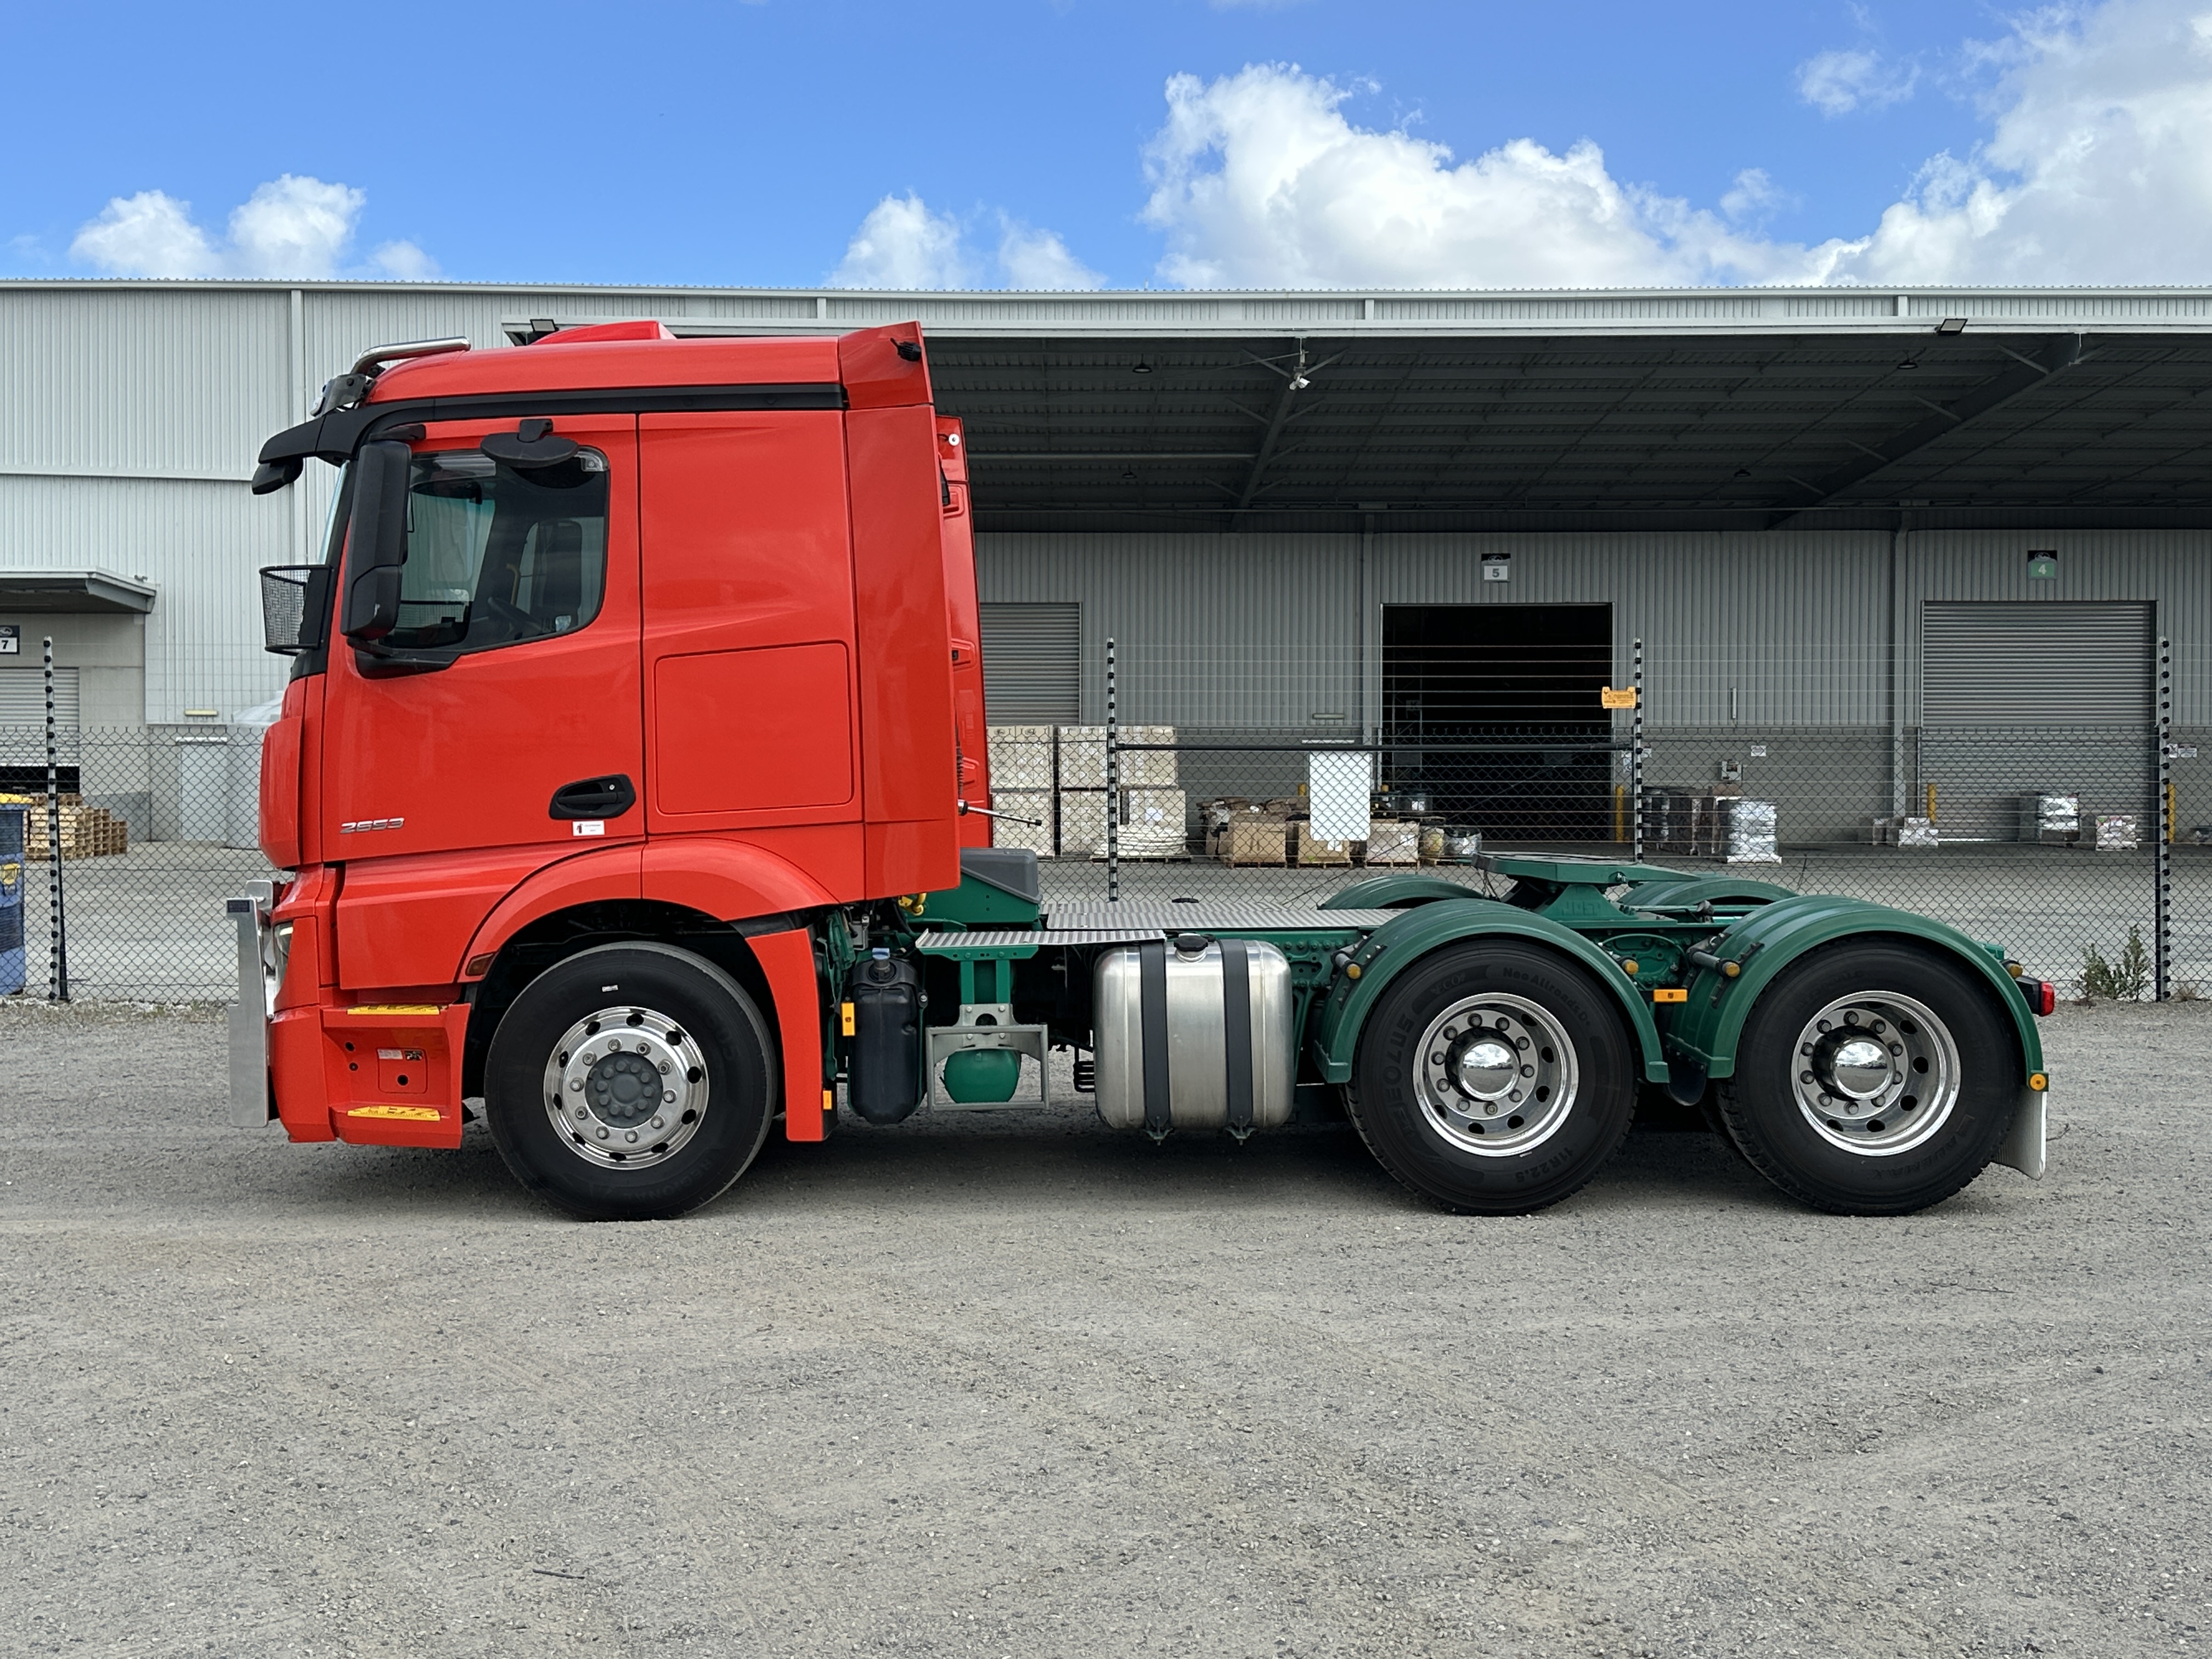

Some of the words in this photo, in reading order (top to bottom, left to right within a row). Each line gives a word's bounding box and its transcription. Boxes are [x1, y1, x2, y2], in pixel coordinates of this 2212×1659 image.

[1492, 568, 1500, 578] 5
[2038, 564, 2047, 575] 4
[2, 640, 8, 650] 7
[340, 817, 405, 833] 2653
[1502, 967, 1530, 981] Neo
[1515, 1146, 1573, 1183] 11R22.5
